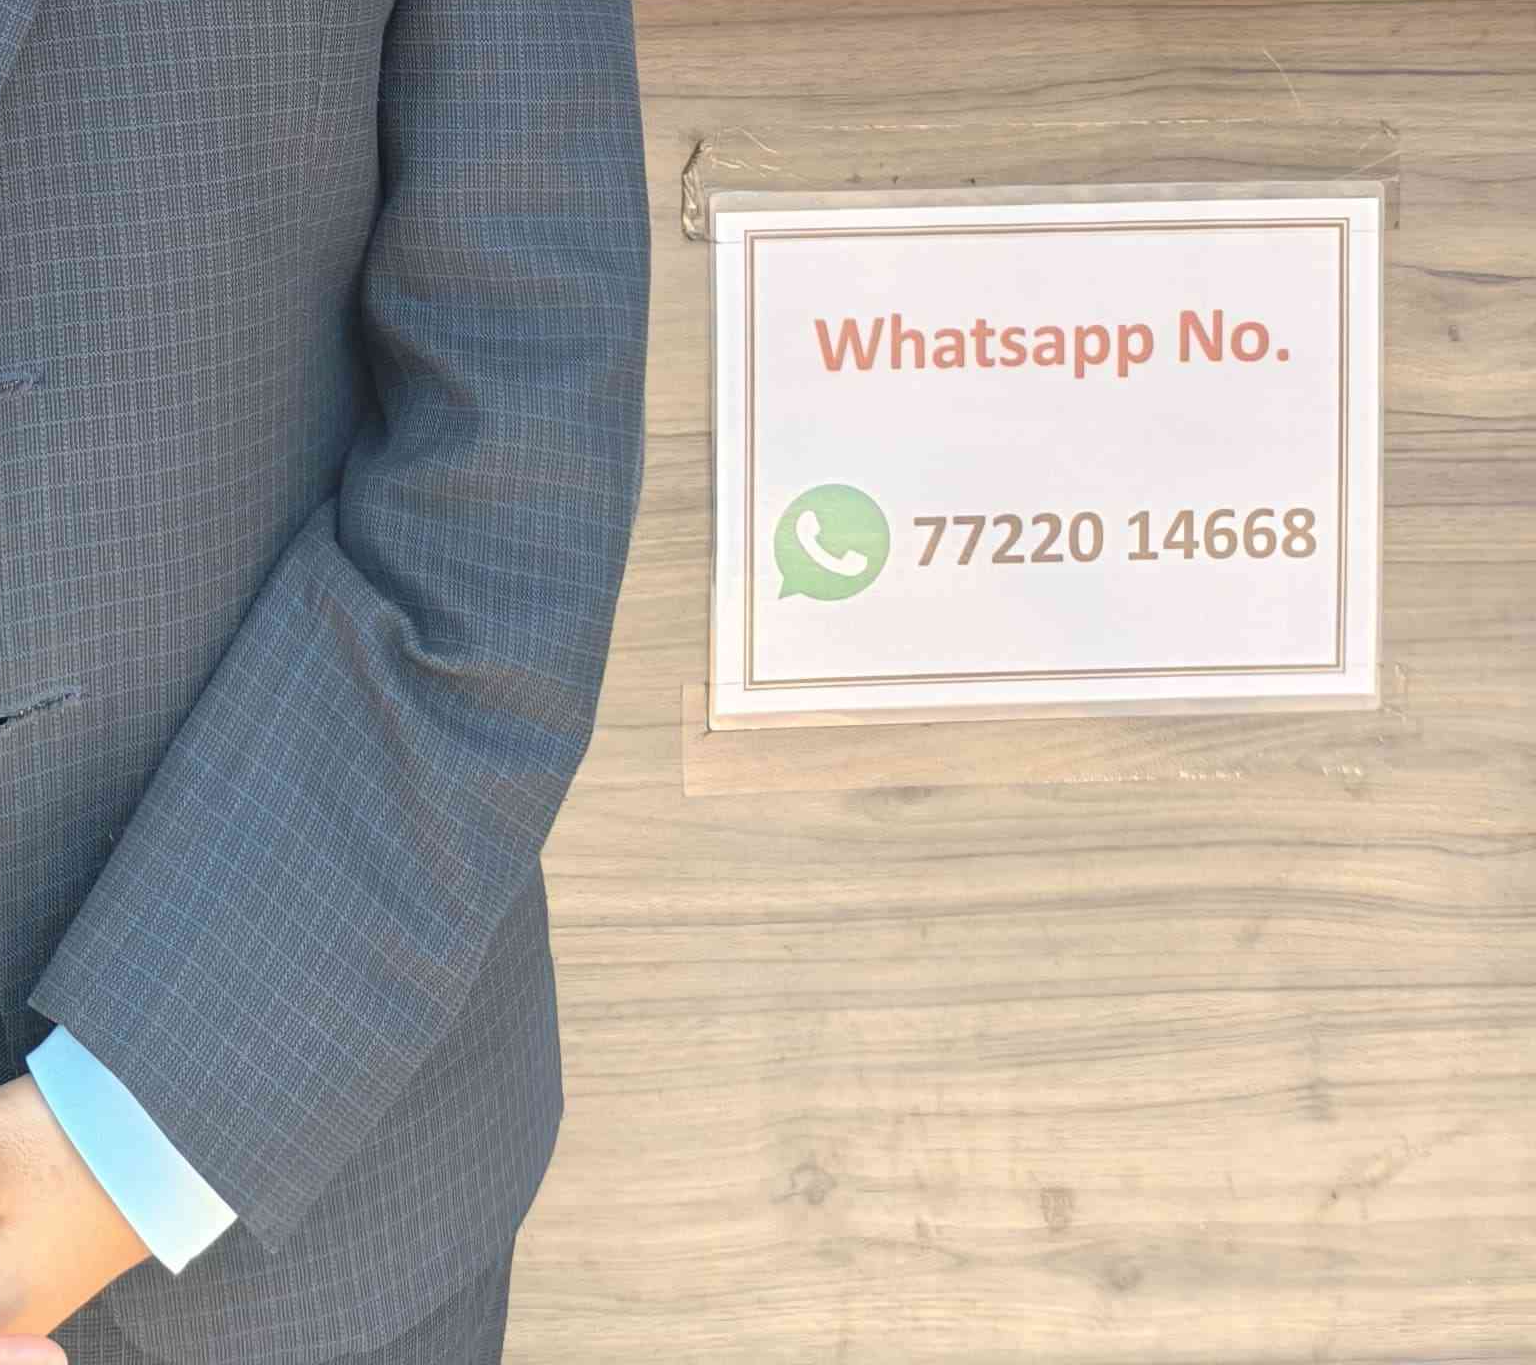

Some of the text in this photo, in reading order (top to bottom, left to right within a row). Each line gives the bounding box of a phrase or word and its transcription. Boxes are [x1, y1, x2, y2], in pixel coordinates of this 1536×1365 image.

[815, 309, 1291, 379] Whatsapp No.
[913, 506, 1318, 567] 77220 14668
